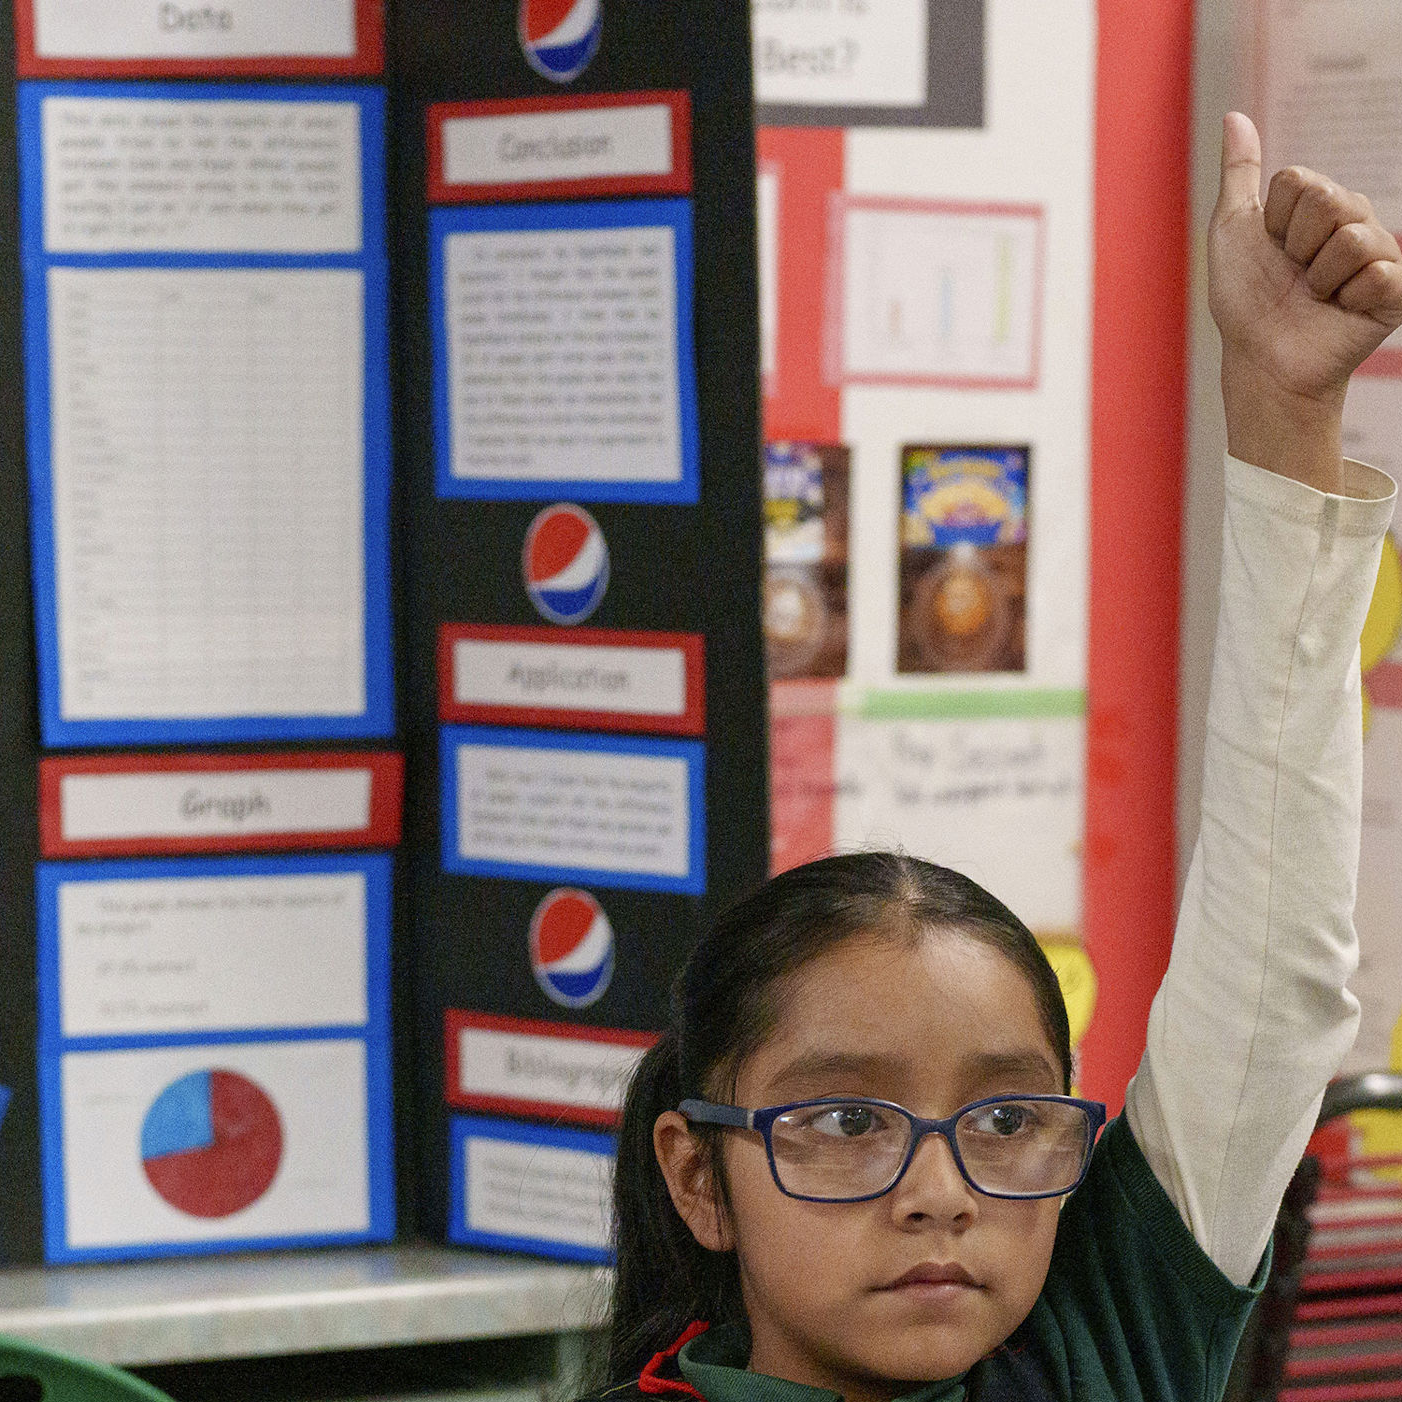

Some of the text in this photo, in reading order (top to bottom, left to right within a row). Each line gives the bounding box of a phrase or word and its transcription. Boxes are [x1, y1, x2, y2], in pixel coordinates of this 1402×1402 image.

[158, 2, 234, 33] Data
[498, 132, 613, 164] Conclusion
[505, 661, 630, 694] Application
[181, 789, 273, 823] Graph
